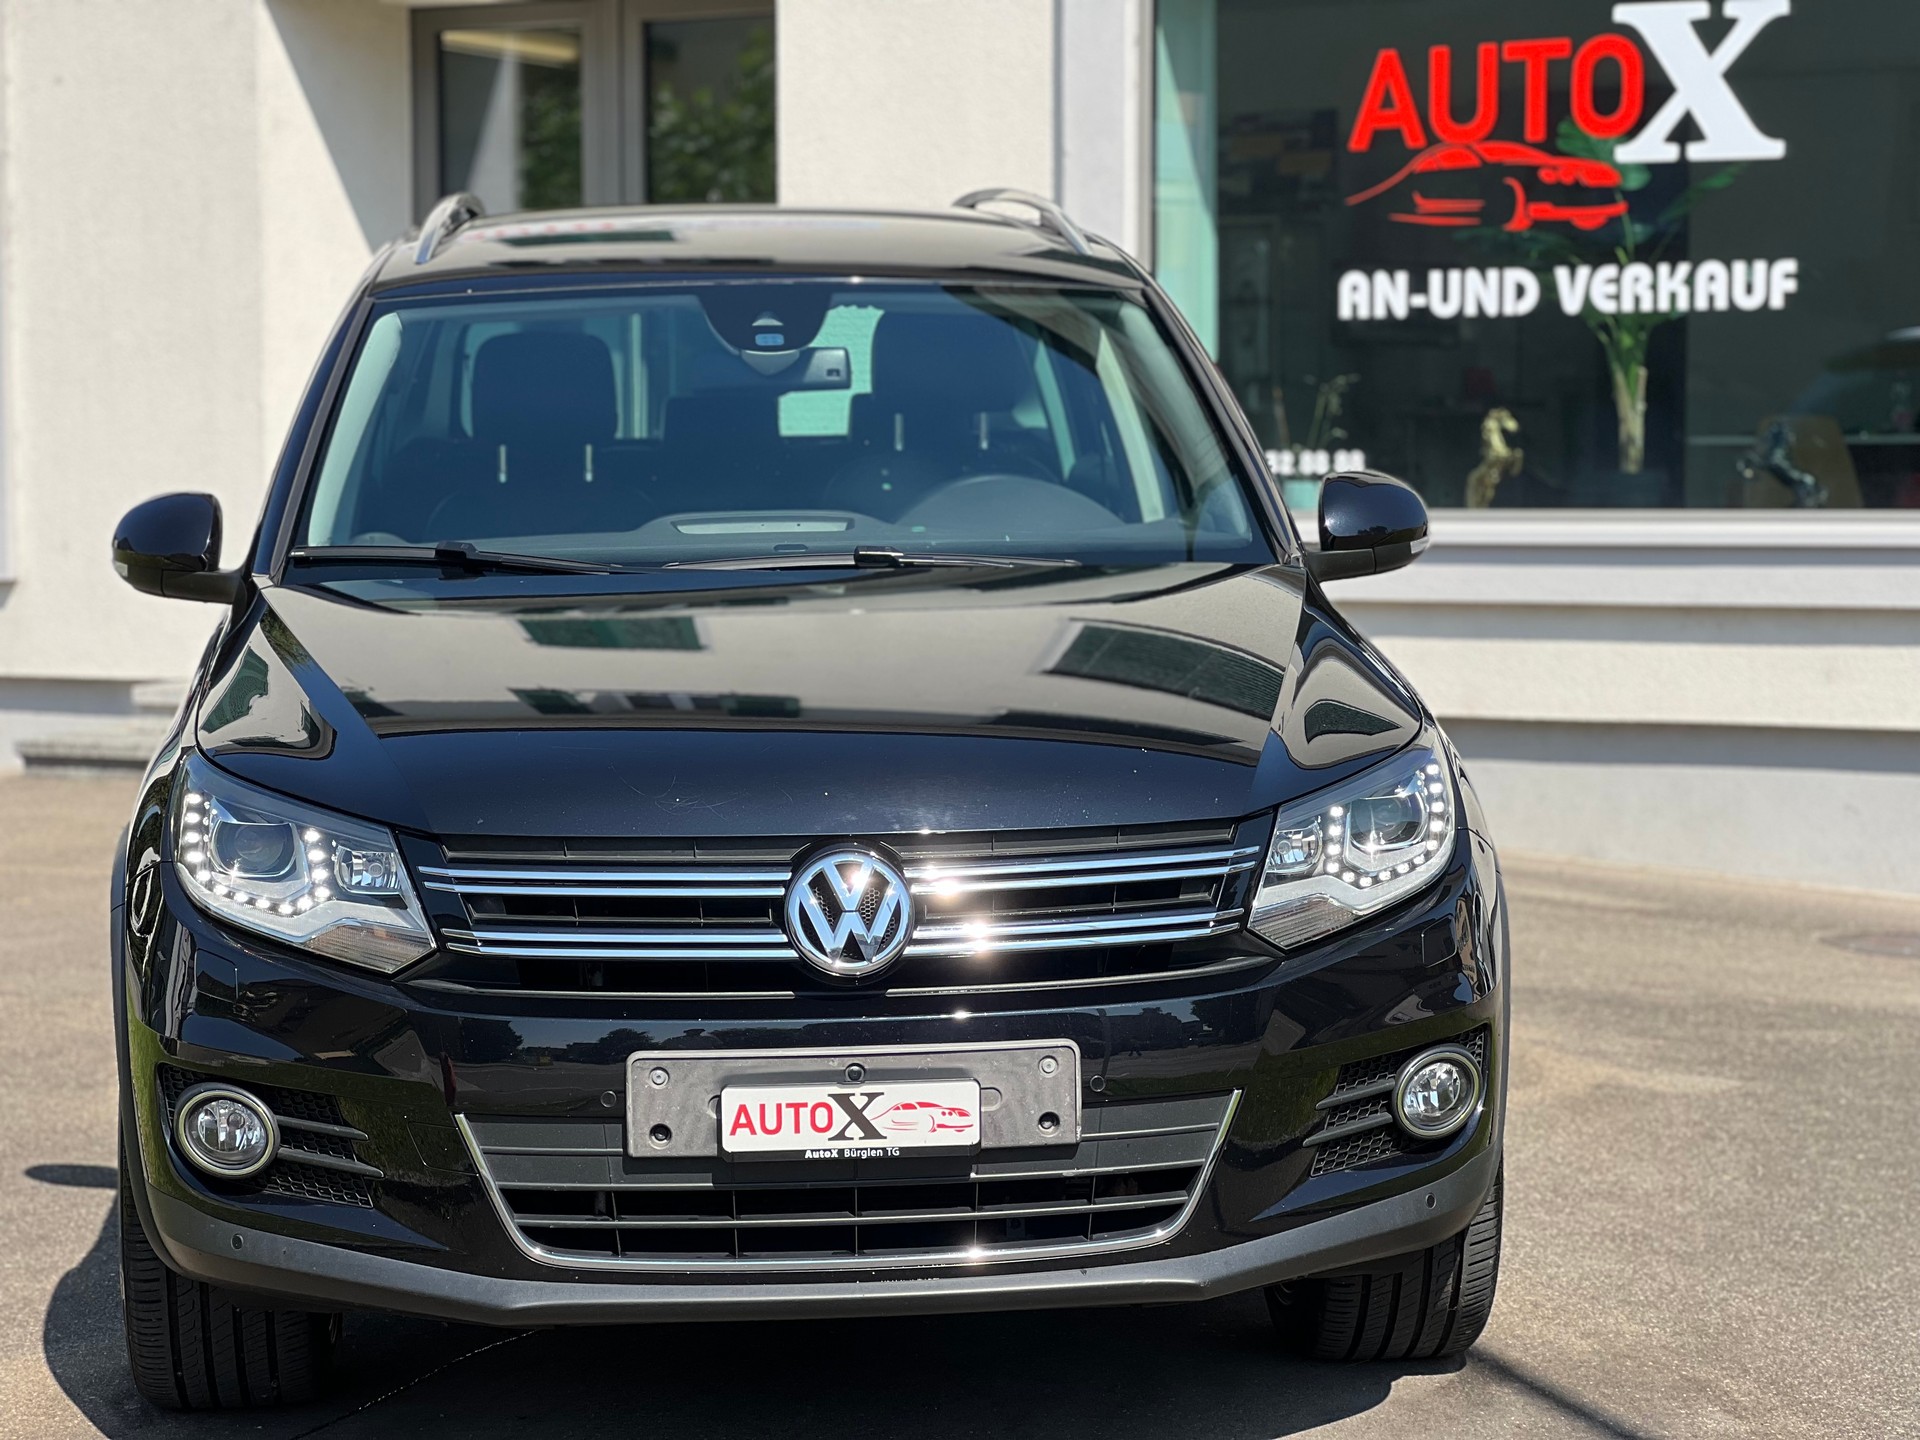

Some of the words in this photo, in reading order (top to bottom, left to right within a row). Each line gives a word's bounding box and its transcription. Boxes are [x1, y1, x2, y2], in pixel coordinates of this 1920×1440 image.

[1337, 266, 1541, 321] AN-UND
[1554, 258, 1798, 316] VERKAUF
[804, 1149, 839, 1159] AutoX
[843, 1147, 883, 1160] Bürglen
[886, 1147, 900, 1156] TG
